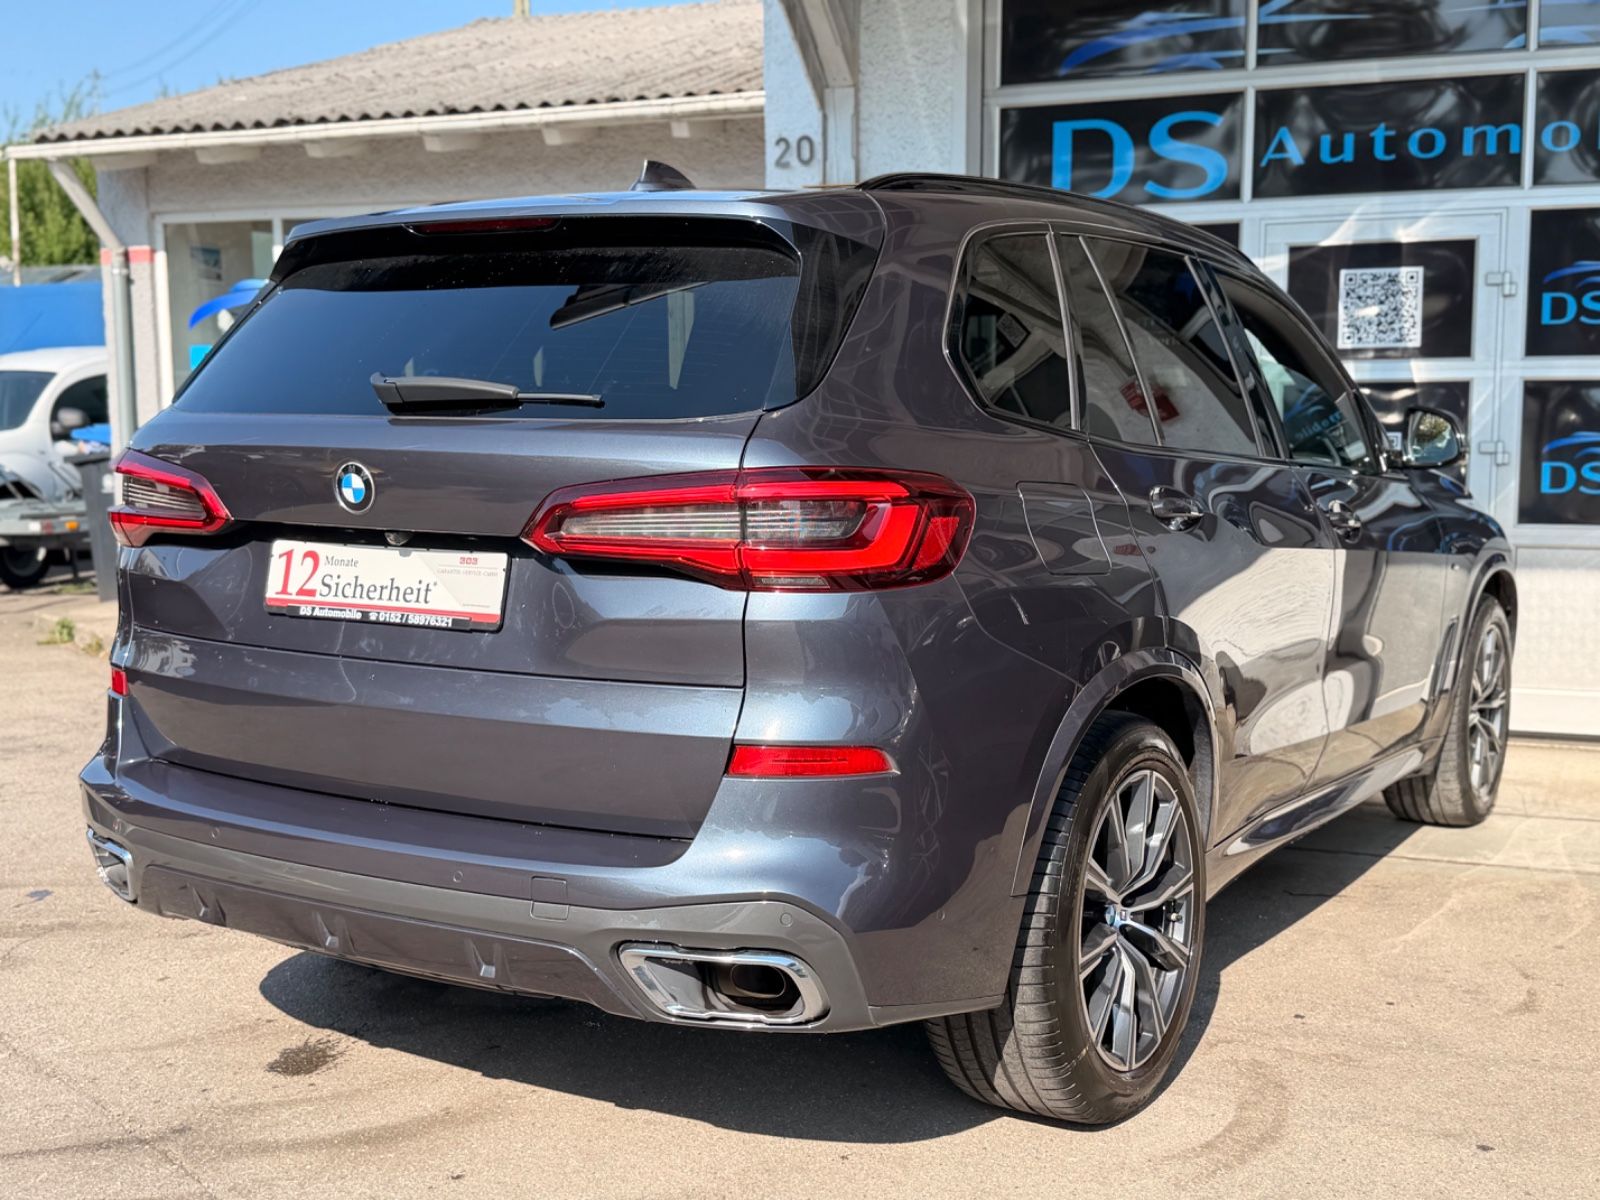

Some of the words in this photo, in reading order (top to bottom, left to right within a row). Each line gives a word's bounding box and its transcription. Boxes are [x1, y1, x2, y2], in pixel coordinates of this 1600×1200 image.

[774, 135, 814, 169] 20
[1051, 110, 1229, 199] DS
[1260, 120, 1600, 168] Automo
[275, 548, 320, 597] 12
[323, 555, 359, 568] Monate
[299, 606, 312, 616] DS
[313, 607, 362, 619] Automobile
[379, 612, 401, 623] 0152
